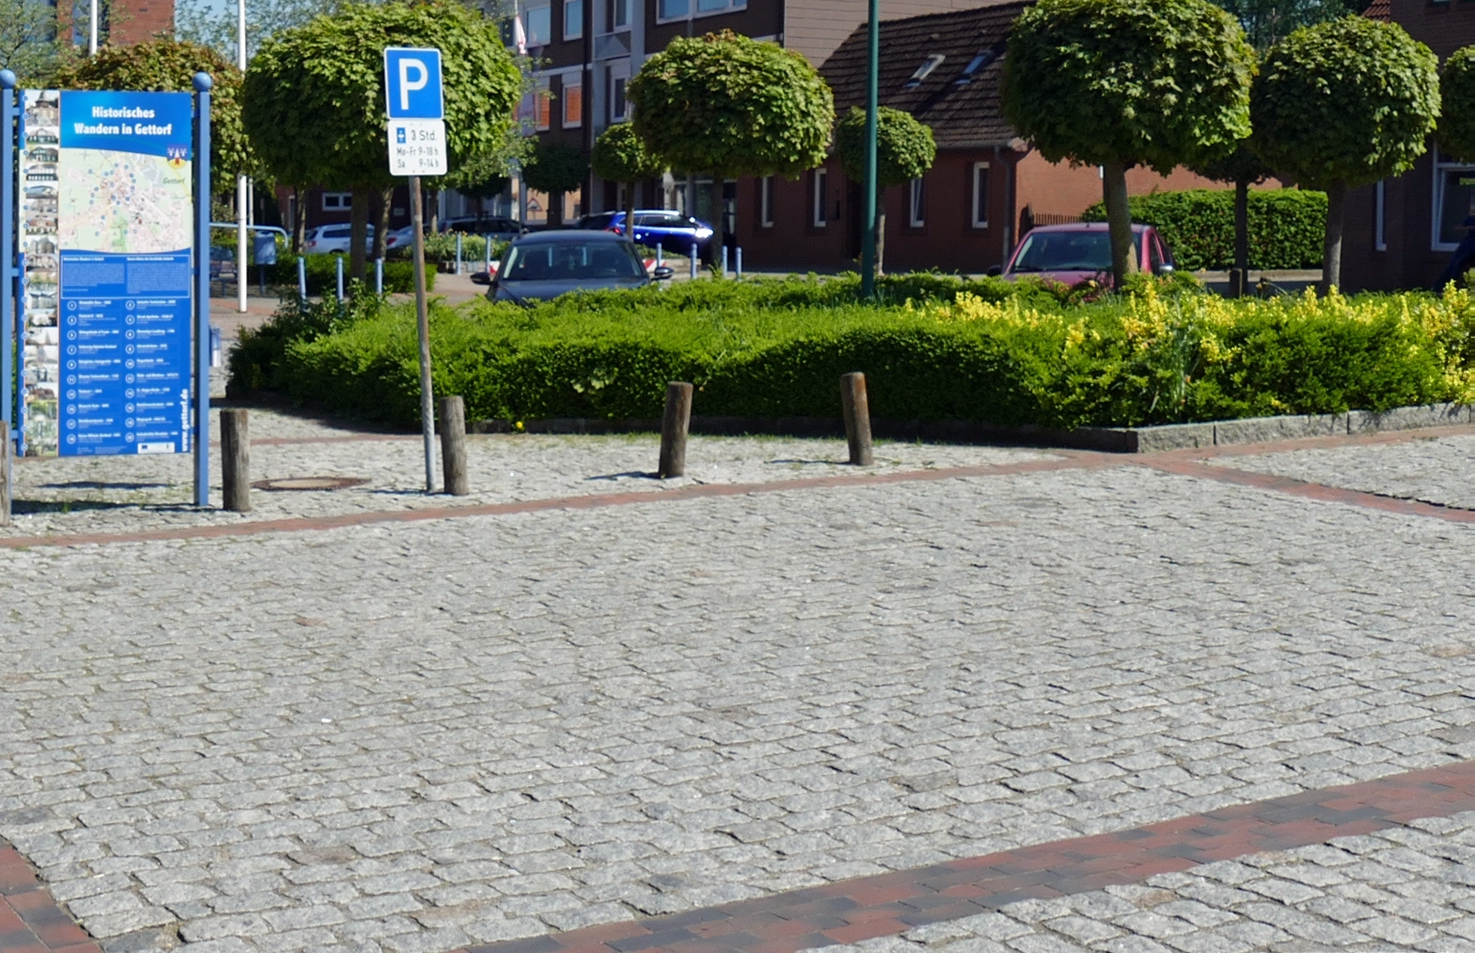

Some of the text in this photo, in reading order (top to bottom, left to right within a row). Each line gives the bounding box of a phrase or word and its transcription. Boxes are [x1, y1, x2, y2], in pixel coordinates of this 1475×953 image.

[398, 58, 428, 110] P
[92, 106, 155, 118] Historisches
[74, 123, 172, 135] Wandern in Gettorf
[411, 130, 416, 141] 3
[397, 159, 405, 168] Sa
[180, 388, 190, 452] www.gettorf.de
